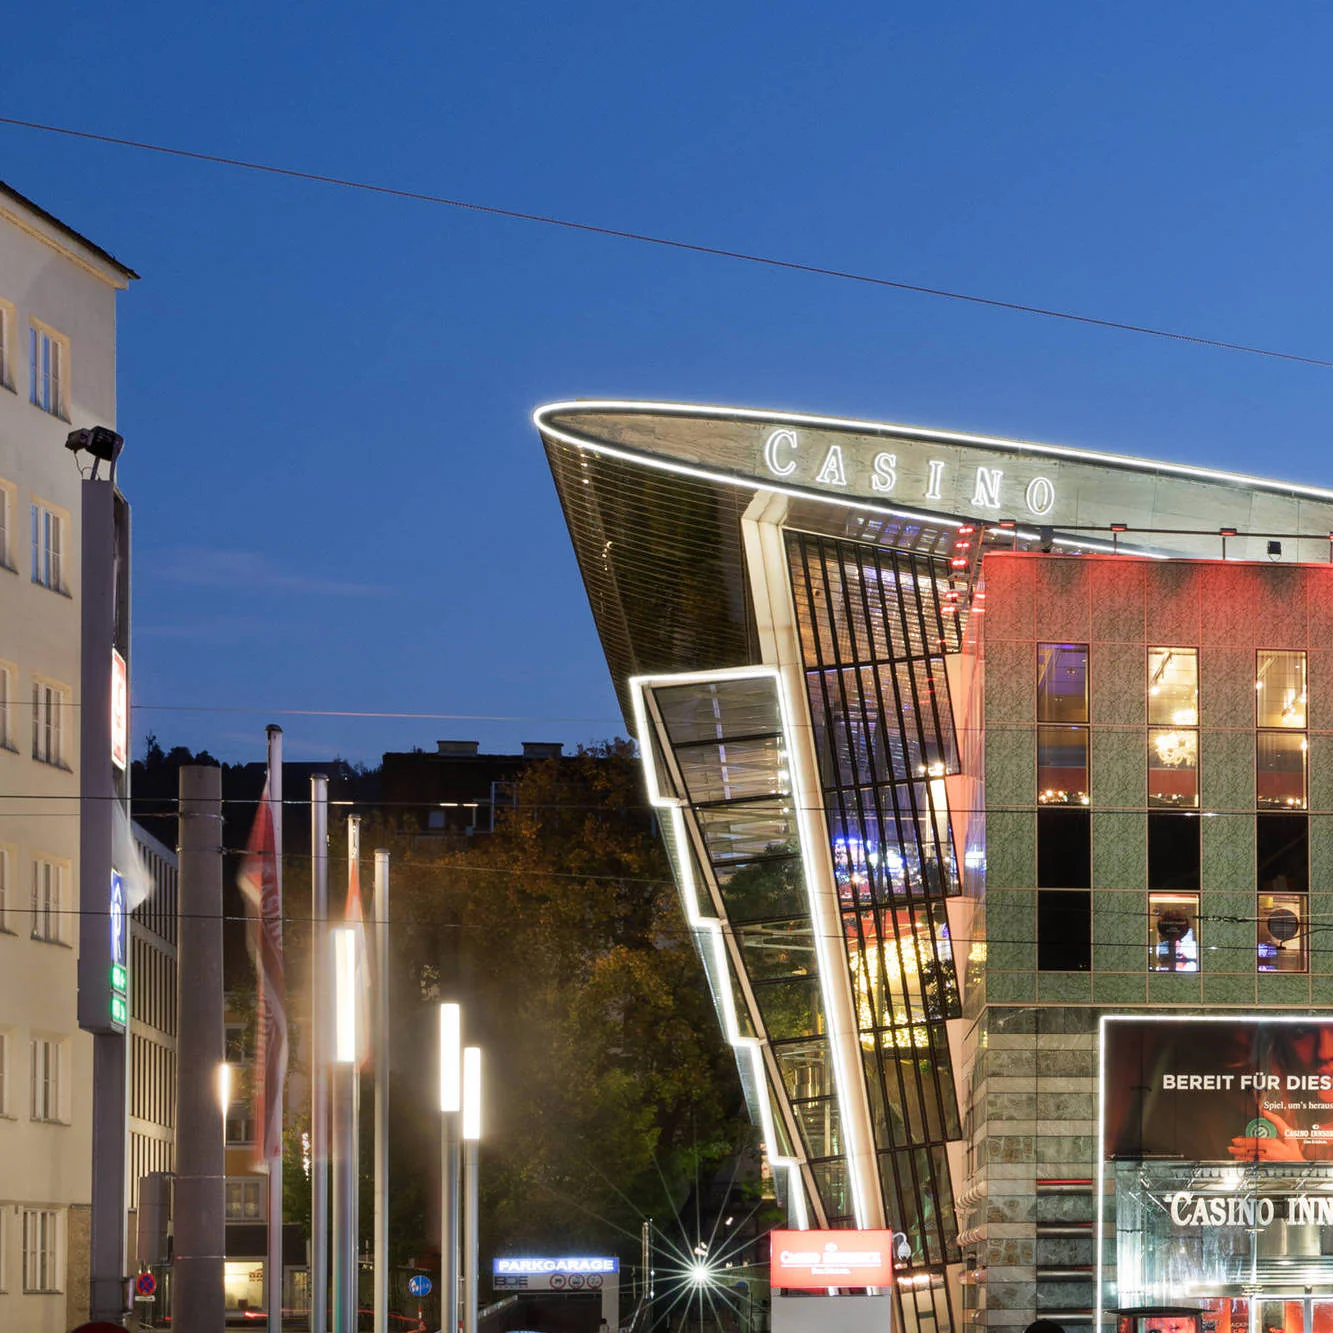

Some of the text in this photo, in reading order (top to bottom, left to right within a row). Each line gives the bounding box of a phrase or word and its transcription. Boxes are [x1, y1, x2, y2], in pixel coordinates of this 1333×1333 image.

[764, 428, 1055, 516] CASINO
[1162, 1074, 1235, 1090] BEREIT
[1240, 1071, 1281, 1090] FÜR
[1263, 1100, 1287, 1110] Spiel,
[1170, 1191, 1275, 1227] CASINO
[499, 1259, 615, 1272] PARKGARAGE
